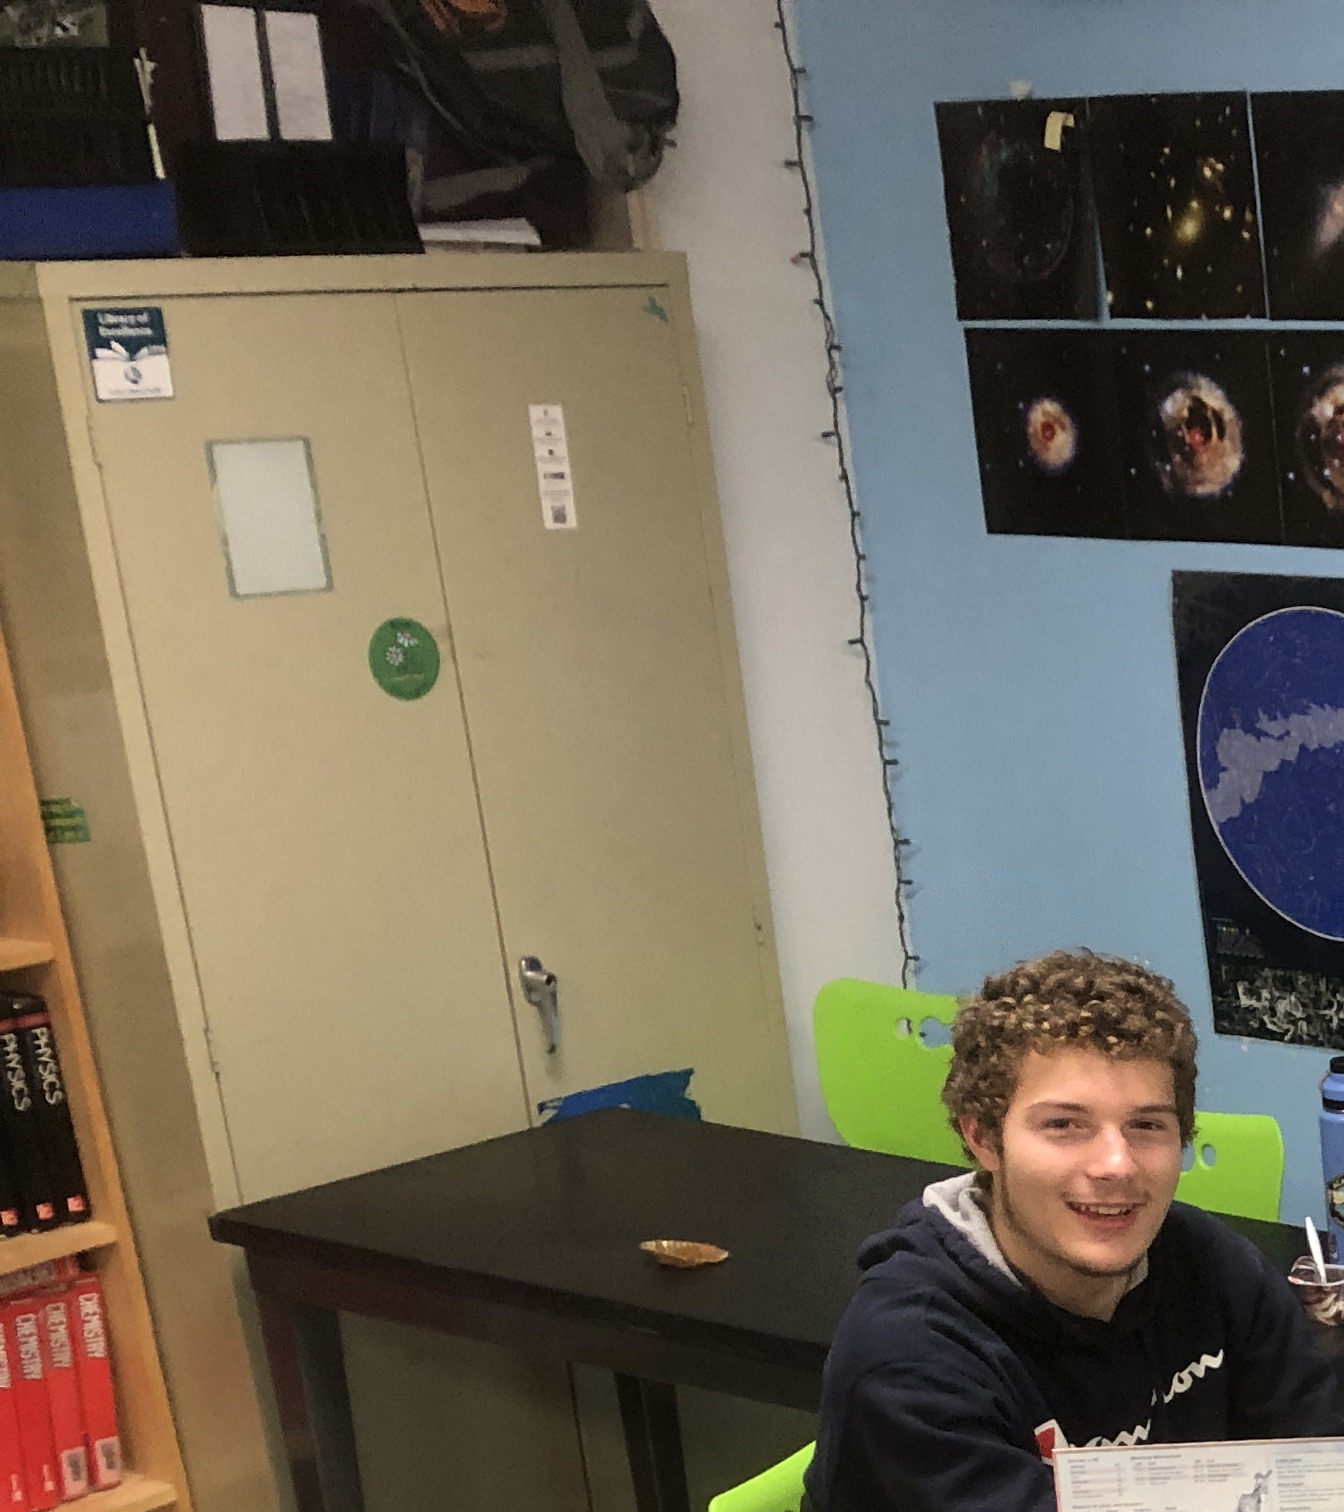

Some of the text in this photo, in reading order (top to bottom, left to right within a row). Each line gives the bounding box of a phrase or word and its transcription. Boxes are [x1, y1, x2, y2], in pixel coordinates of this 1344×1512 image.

[31, 1026, 64, 1105] PHYSICS
[15, 1313, 43, 1380] CHEMISTRY
[45, 1301, 73, 1369] CHEMISTRY
[78, 1292, 108, 1358] CHEMISTRY
